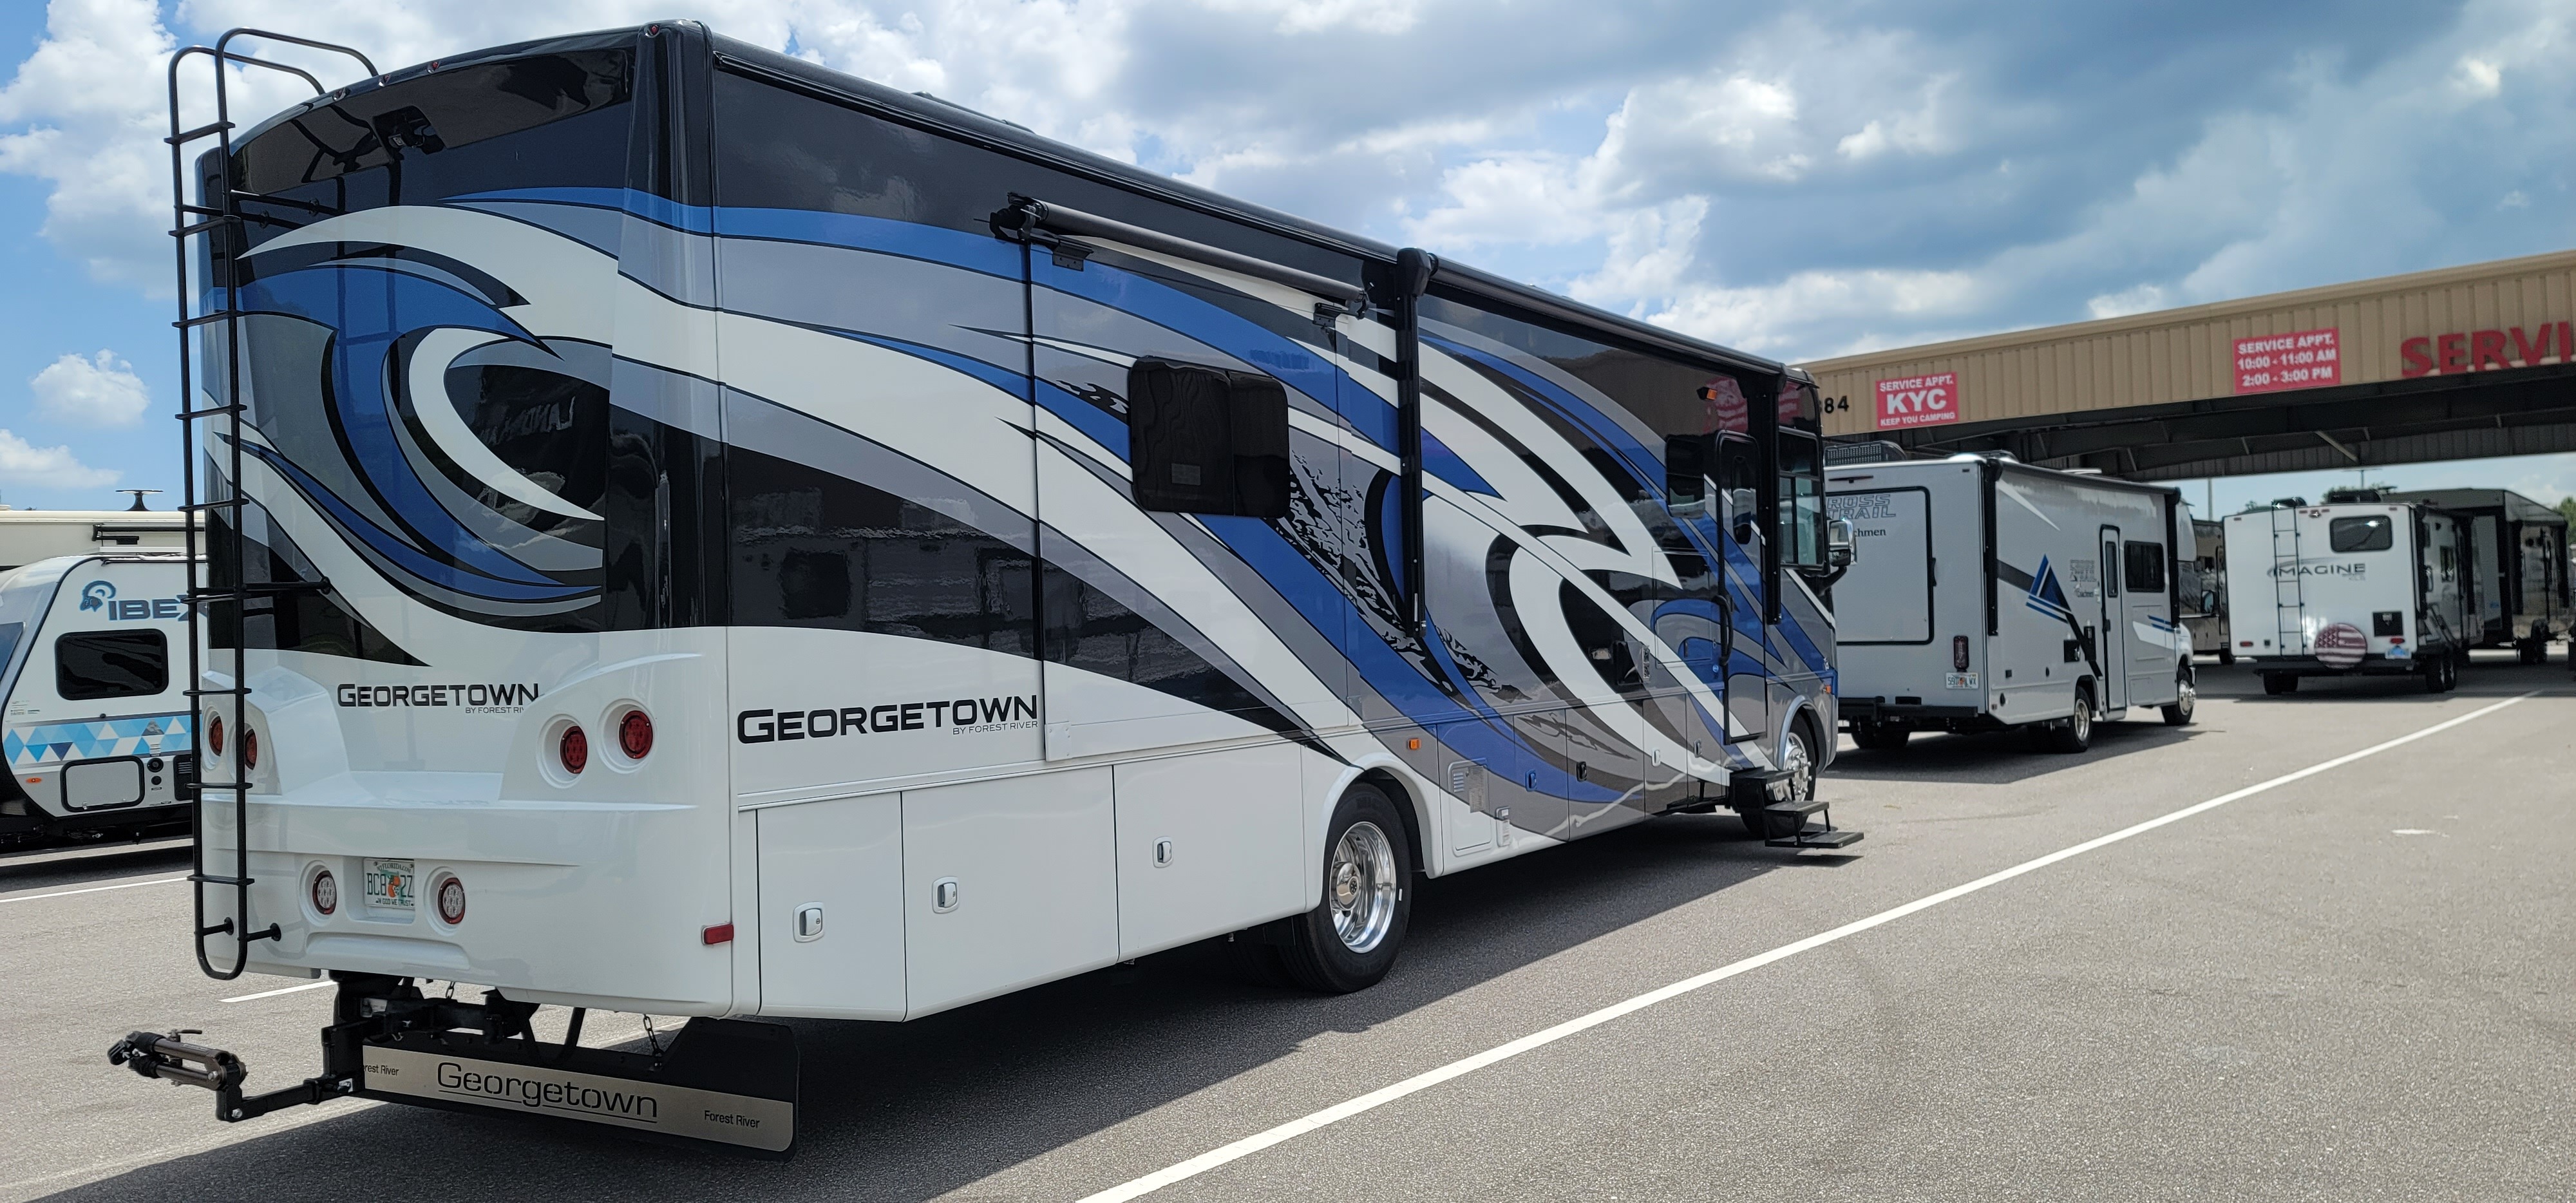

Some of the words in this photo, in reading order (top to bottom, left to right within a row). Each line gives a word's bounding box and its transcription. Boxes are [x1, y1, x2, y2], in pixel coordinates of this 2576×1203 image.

[2238, 337, 2294, 355] SERVICE
[2297, 332, 2335, 348] APPT.
[2400, 321, 2573, 378] SERVI
[2237, 355, 2271, 371] 10:00
[2280, 351, 2314, 366] 11:00
[2316, 347, 2337, 362] AM
[1879, 378, 1923, 392] SERVICE
[1924, 374, 1954, 387] APPT.
[2242, 372, 2271, 387] 2:00
[2280, 368, 2309, 383] 3:00
[2311, 365, 2333, 380] PM
[1819, 395, 1850, 414] 84
[1886, 388, 1947, 415] KYC
[1880, 417, 1900, 426] KEEP
[1901, 415, 1918, 424] YOU
[1919, 411, 1956, 422] CAMPING
[1826, 506, 1897, 520] TRAIL
[337, 683, 540, 707] GEORGETOWN
[737, 694, 1038, 744] GEORGETOWN
[952, 726, 967, 735] BY
[969, 723, 1008, 734] FOREST
[1009, 721, 1038, 730] RIVER
[380, 1065, 400, 1076] River
[437, 1061, 658, 1118] Georgetown
[703, 1110, 734, 1125] Forest
[735, 1114, 761, 1129] River
